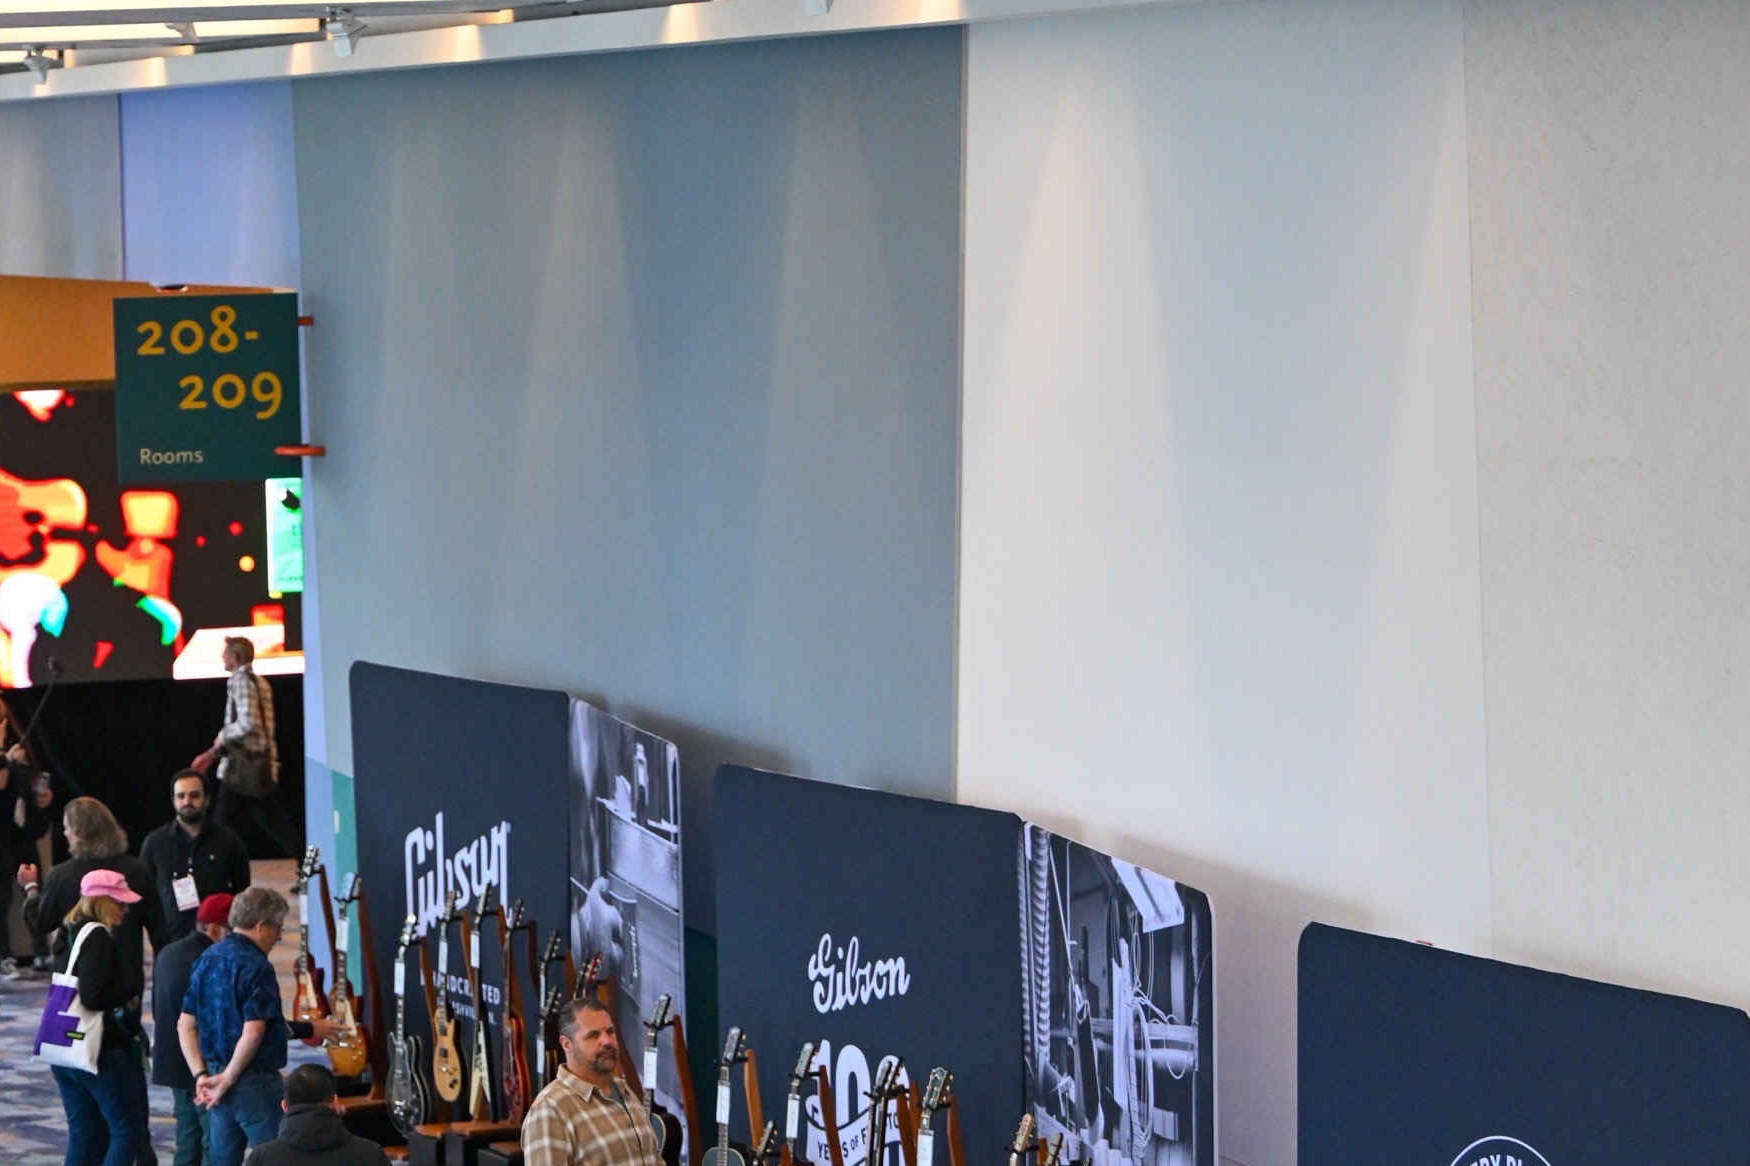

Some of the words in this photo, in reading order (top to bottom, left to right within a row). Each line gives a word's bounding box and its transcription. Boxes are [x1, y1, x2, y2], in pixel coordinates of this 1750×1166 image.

[137, 304, 259, 356] 208-
[179, 371, 282, 420] 209
[140, 448, 203, 465] Rooms
[404, 811, 512, 938] Gibson
[807, 933, 911, 1014] Gibson
[817, 1140, 849, 1165] YES
[850, 1135, 859, 1150] OF
